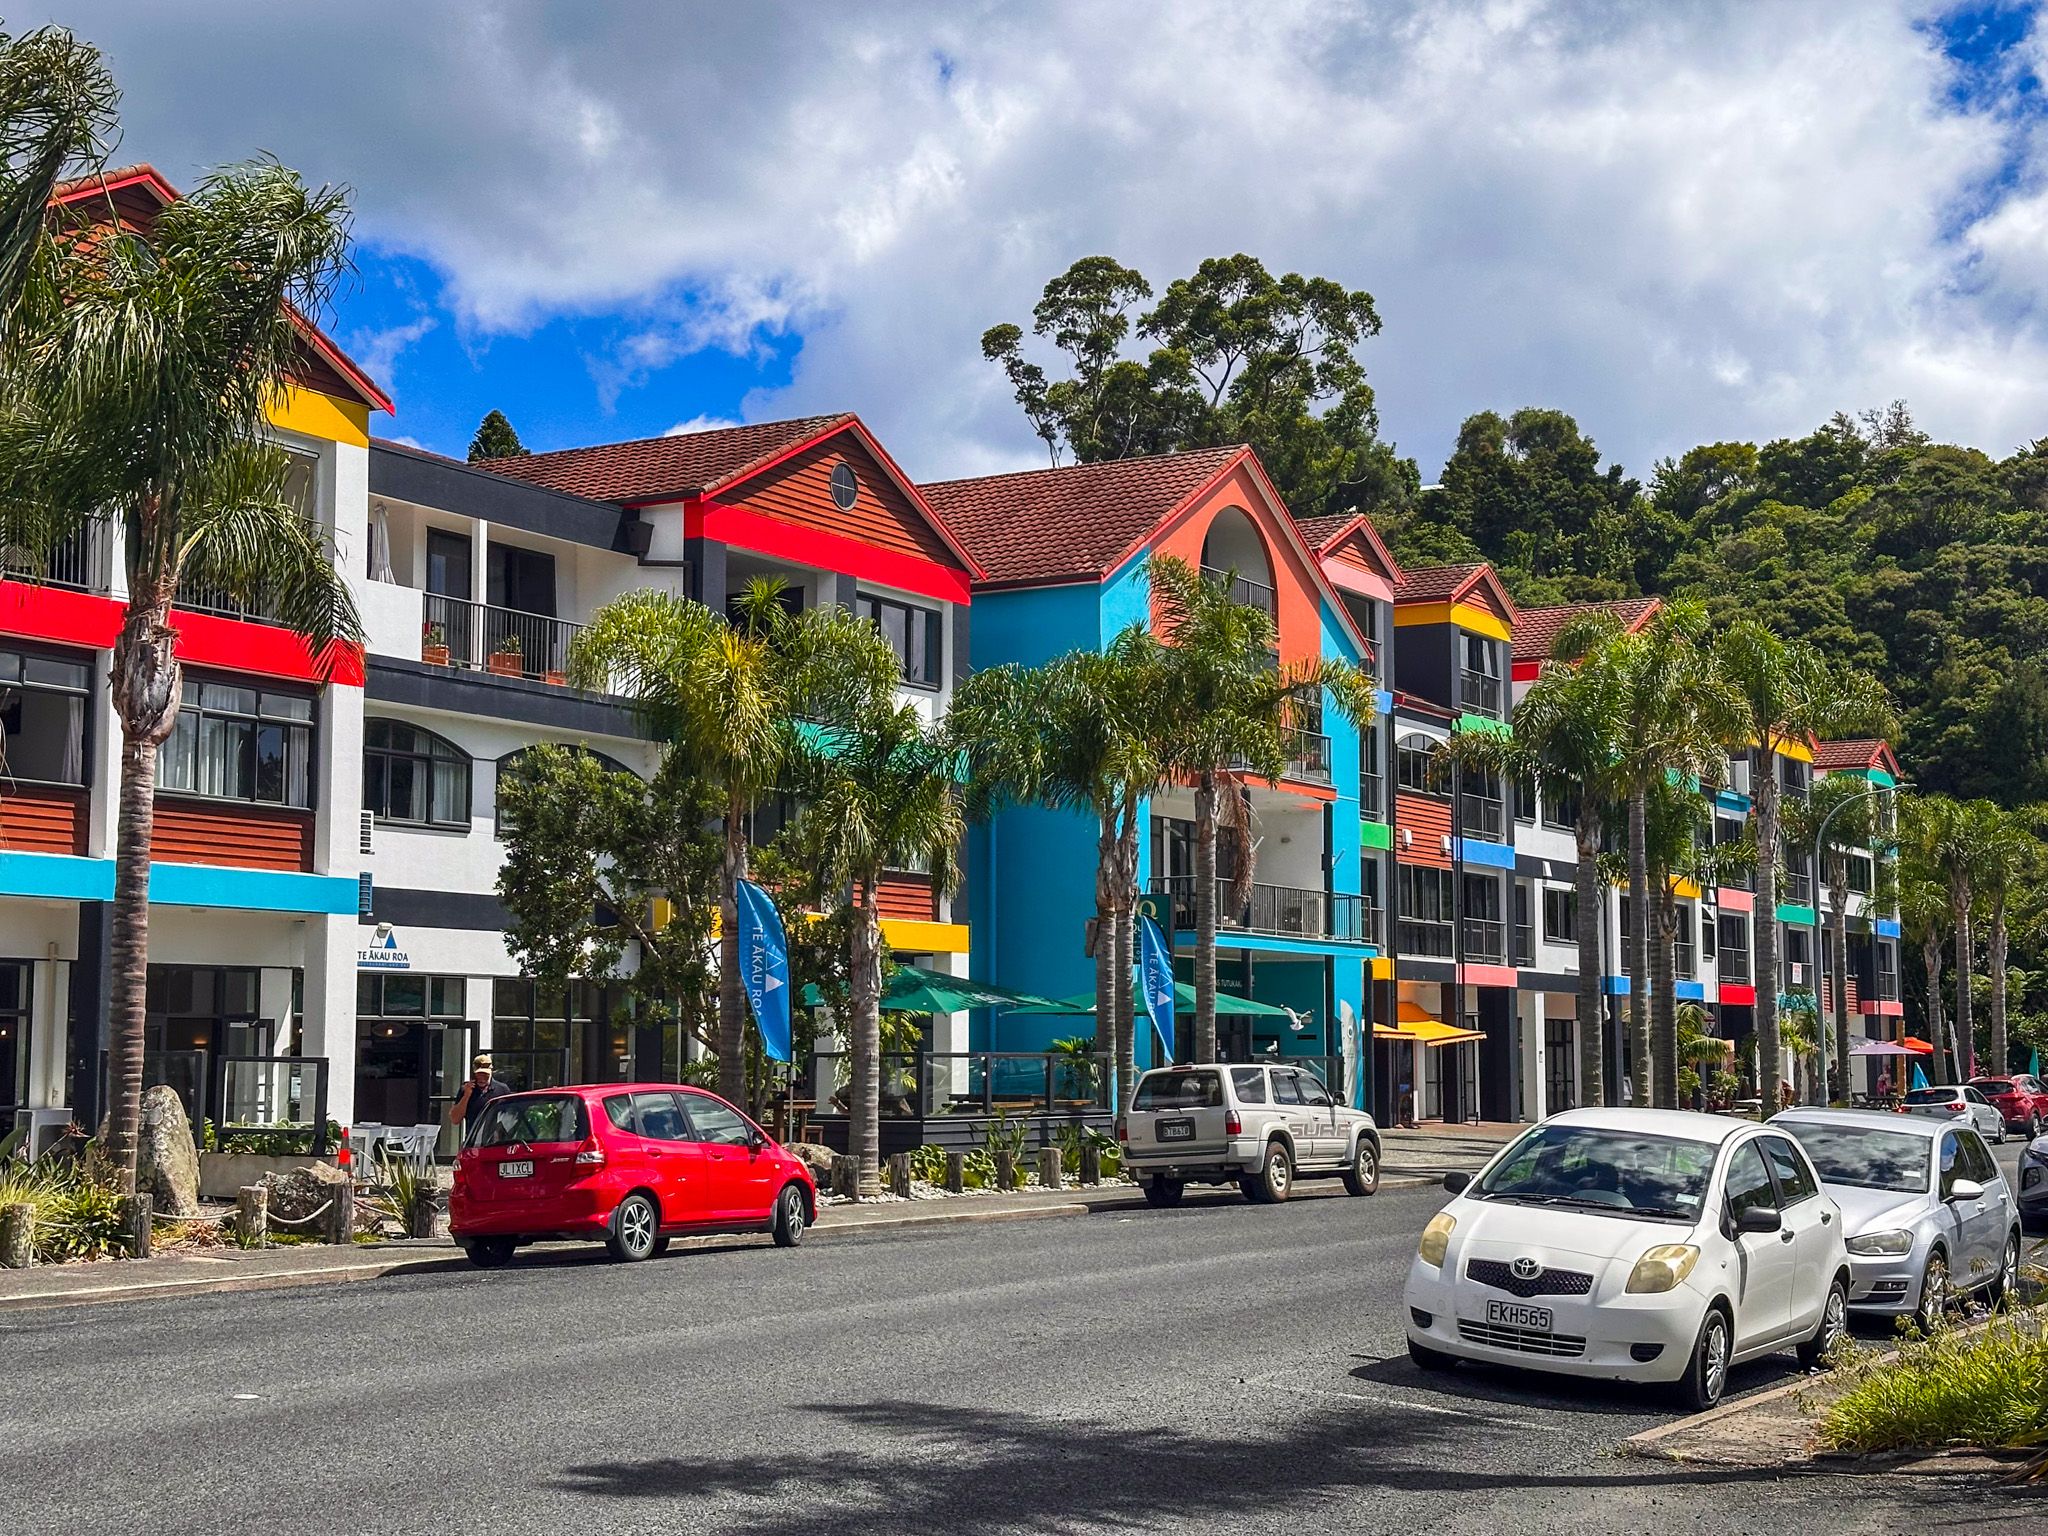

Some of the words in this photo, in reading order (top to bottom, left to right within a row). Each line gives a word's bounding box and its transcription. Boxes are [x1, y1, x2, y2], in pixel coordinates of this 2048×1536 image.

[752, 926, 763, 941] TE
[357, 951, 367, 961] TE
[368, 950, 391, 961] ĀKAU
[392, 952, 409, 962] ROA
[1149, 951, 1159, 965] TE
[752, 944, 765, 984] ĀKAU
[1289, 1123, 1351, 1137] SURF
[1490, 1304, 1548, 1327] EKH565
